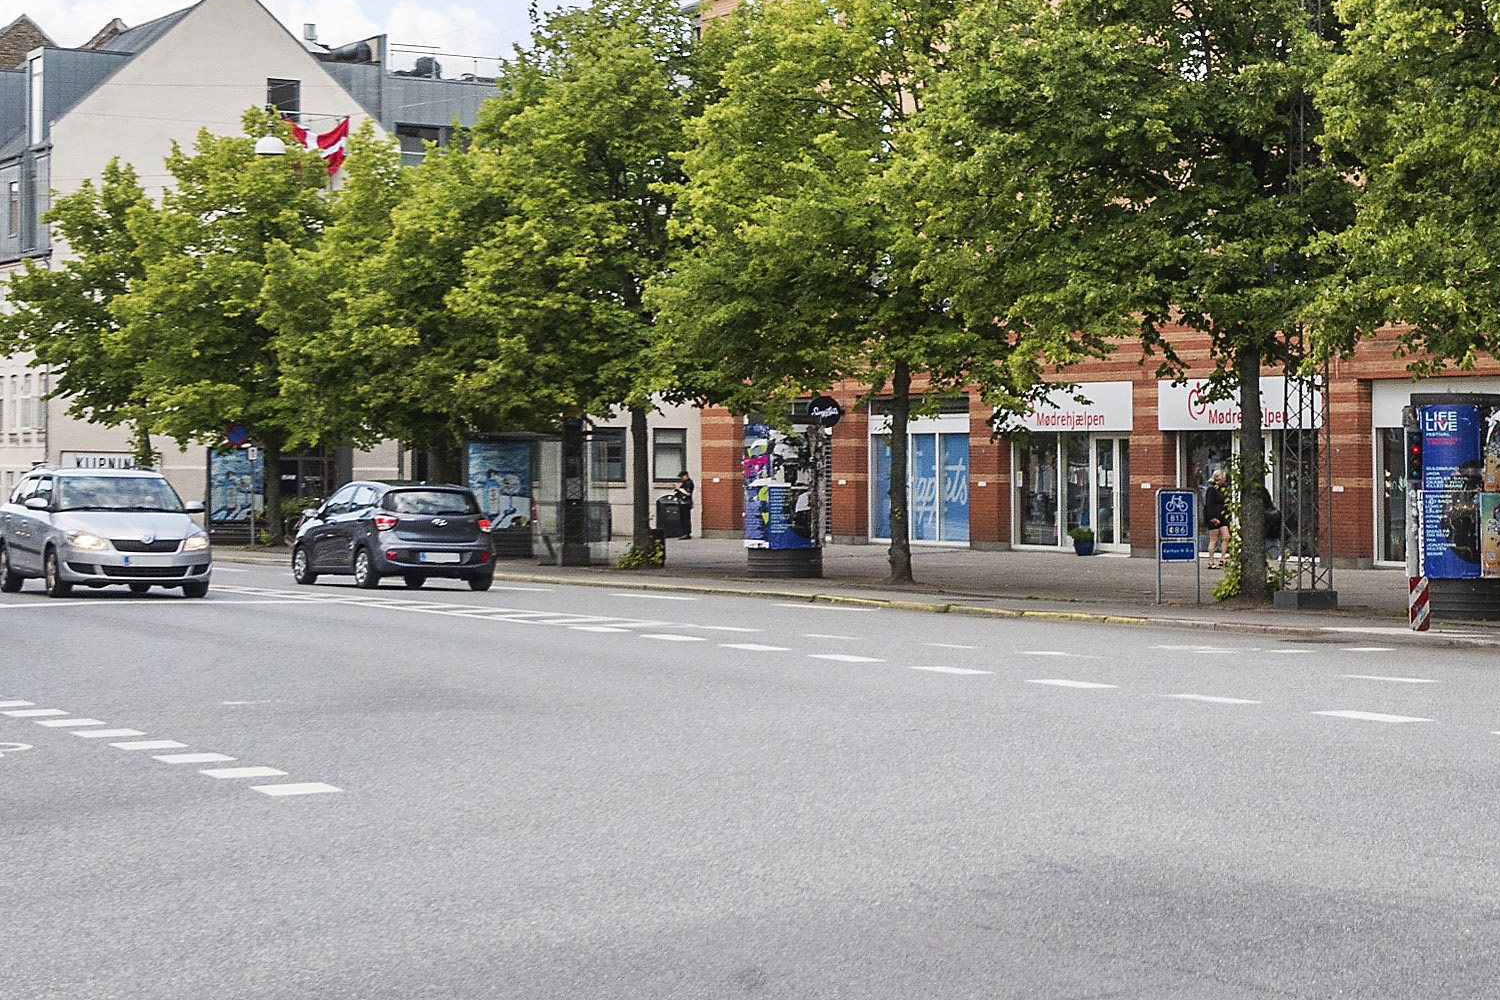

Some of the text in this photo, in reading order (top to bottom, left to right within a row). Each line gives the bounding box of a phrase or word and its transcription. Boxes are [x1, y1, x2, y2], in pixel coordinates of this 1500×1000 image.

[1036, 411, 1105, 430] Mødrehjælpen
[1425, 411, 1457, 421] LIFE
[1425, 421, 1457, 431] LIVE
